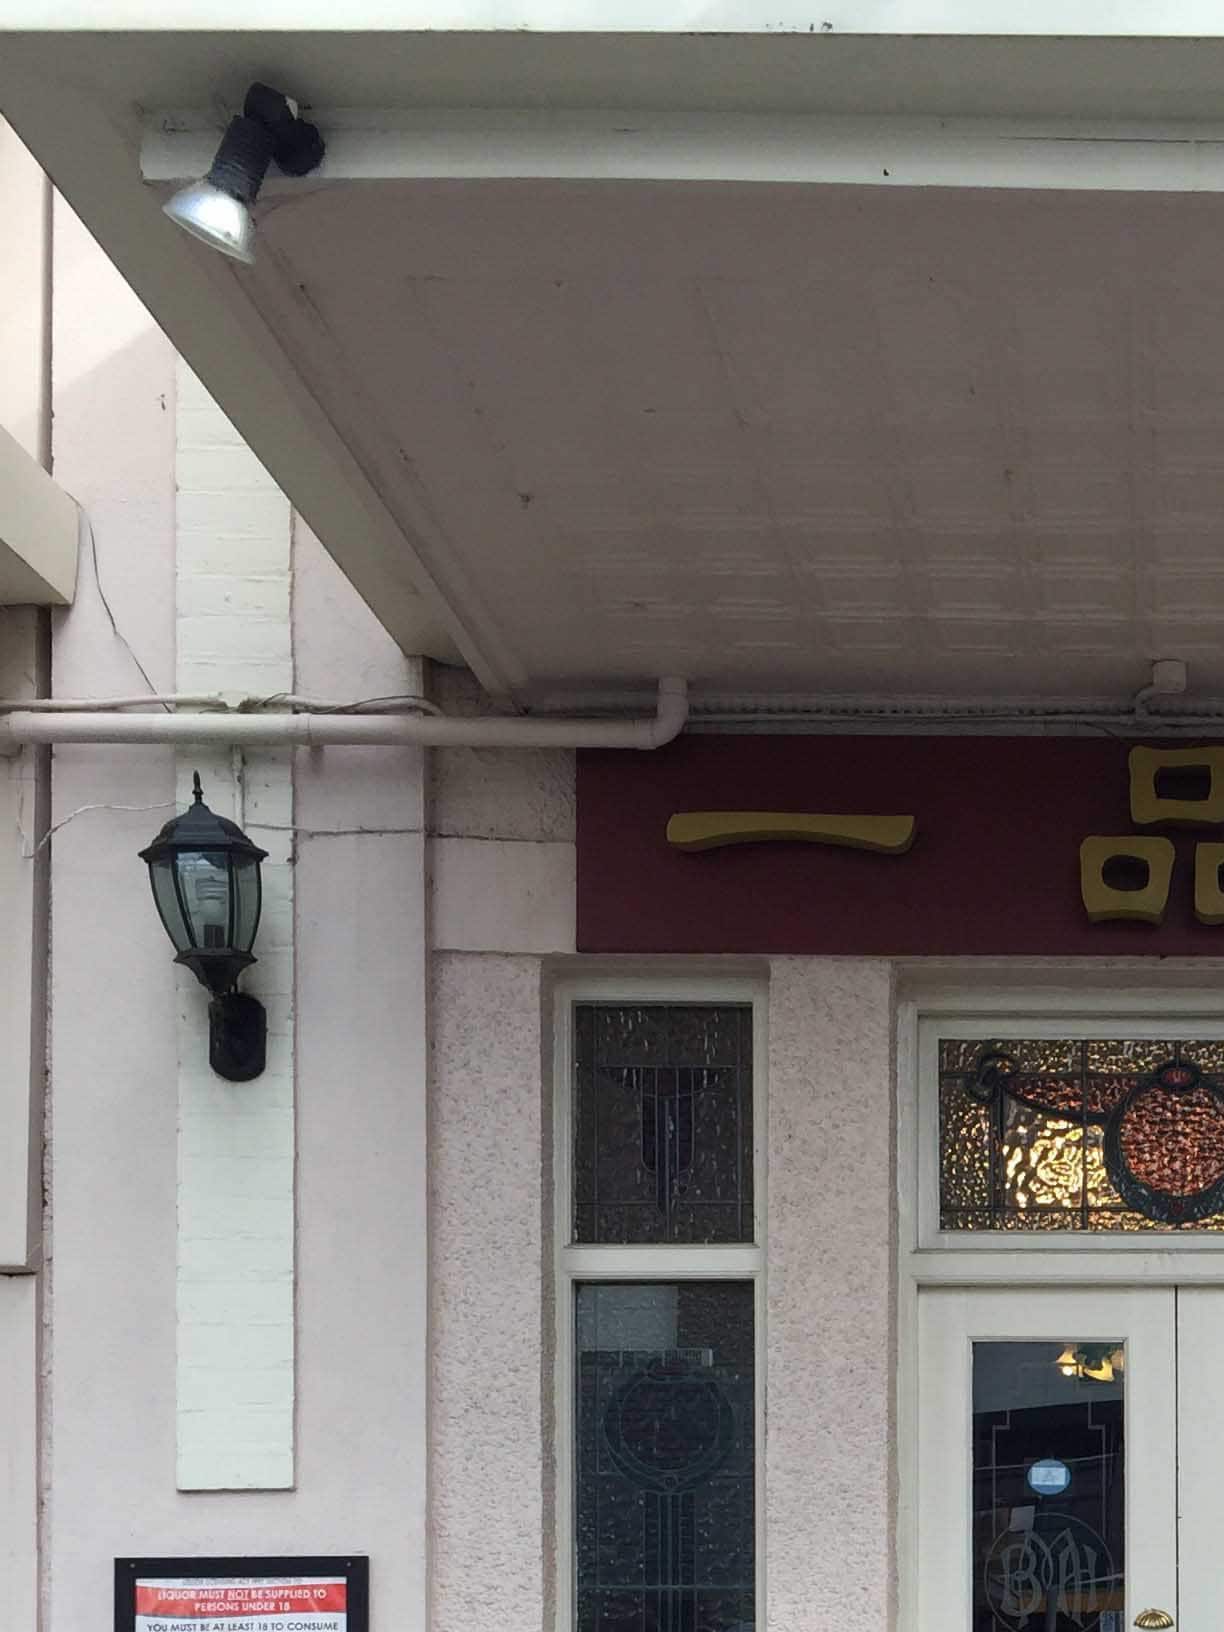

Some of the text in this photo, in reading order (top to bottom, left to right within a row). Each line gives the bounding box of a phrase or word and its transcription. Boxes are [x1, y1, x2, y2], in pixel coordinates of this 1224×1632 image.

[158, 1589, 327, 1600] LIQUOR MUST NOT BE SUPPLIED TO
[194, 1601, 290, 1612] PERSONS UNDER 18
[147, 1622, 338, 1632] YOU MUST BE AT LEAST 18 TO CONSUME
